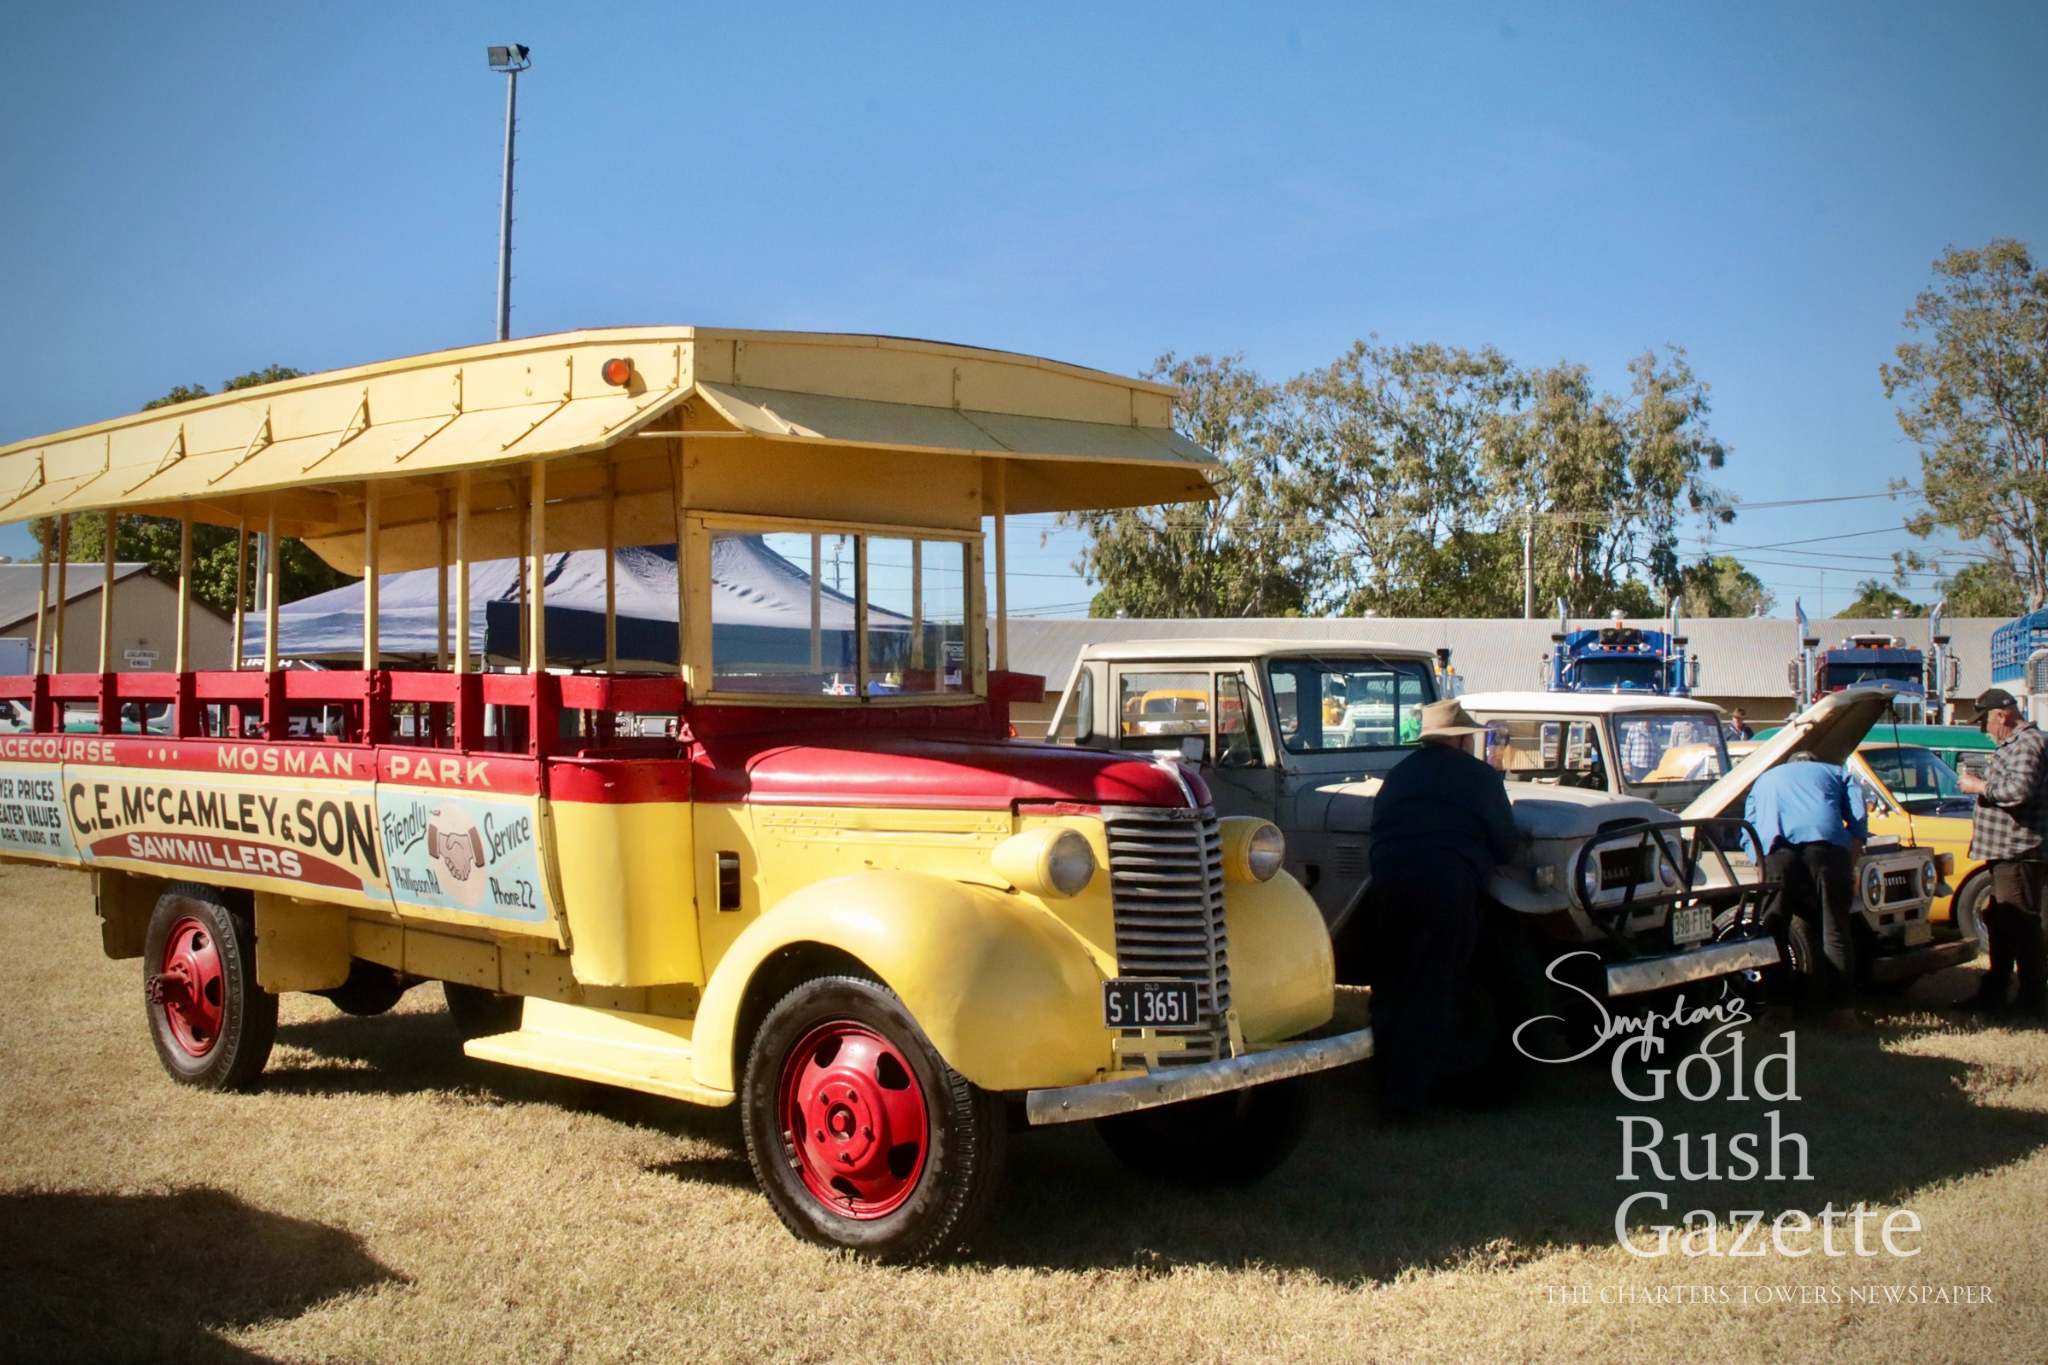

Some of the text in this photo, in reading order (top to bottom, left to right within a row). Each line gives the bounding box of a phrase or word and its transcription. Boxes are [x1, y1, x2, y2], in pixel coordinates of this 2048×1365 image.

[217, 746, 491, 787] MOSMAN PARK
[18, 779, 55, 802] PRICES
[25, 805, 62, 829] VALUES
[382, 801, 531, 865] Friendly Service
[1, 827, 61, 847] ARE YOURS AT
[296, 799, 380, 878] SON
[126, 833, 302, 878] SAWMILLERS
[489, 876, 537, 909] Phone 22
[1144, 983, 1160, 991] QLD
